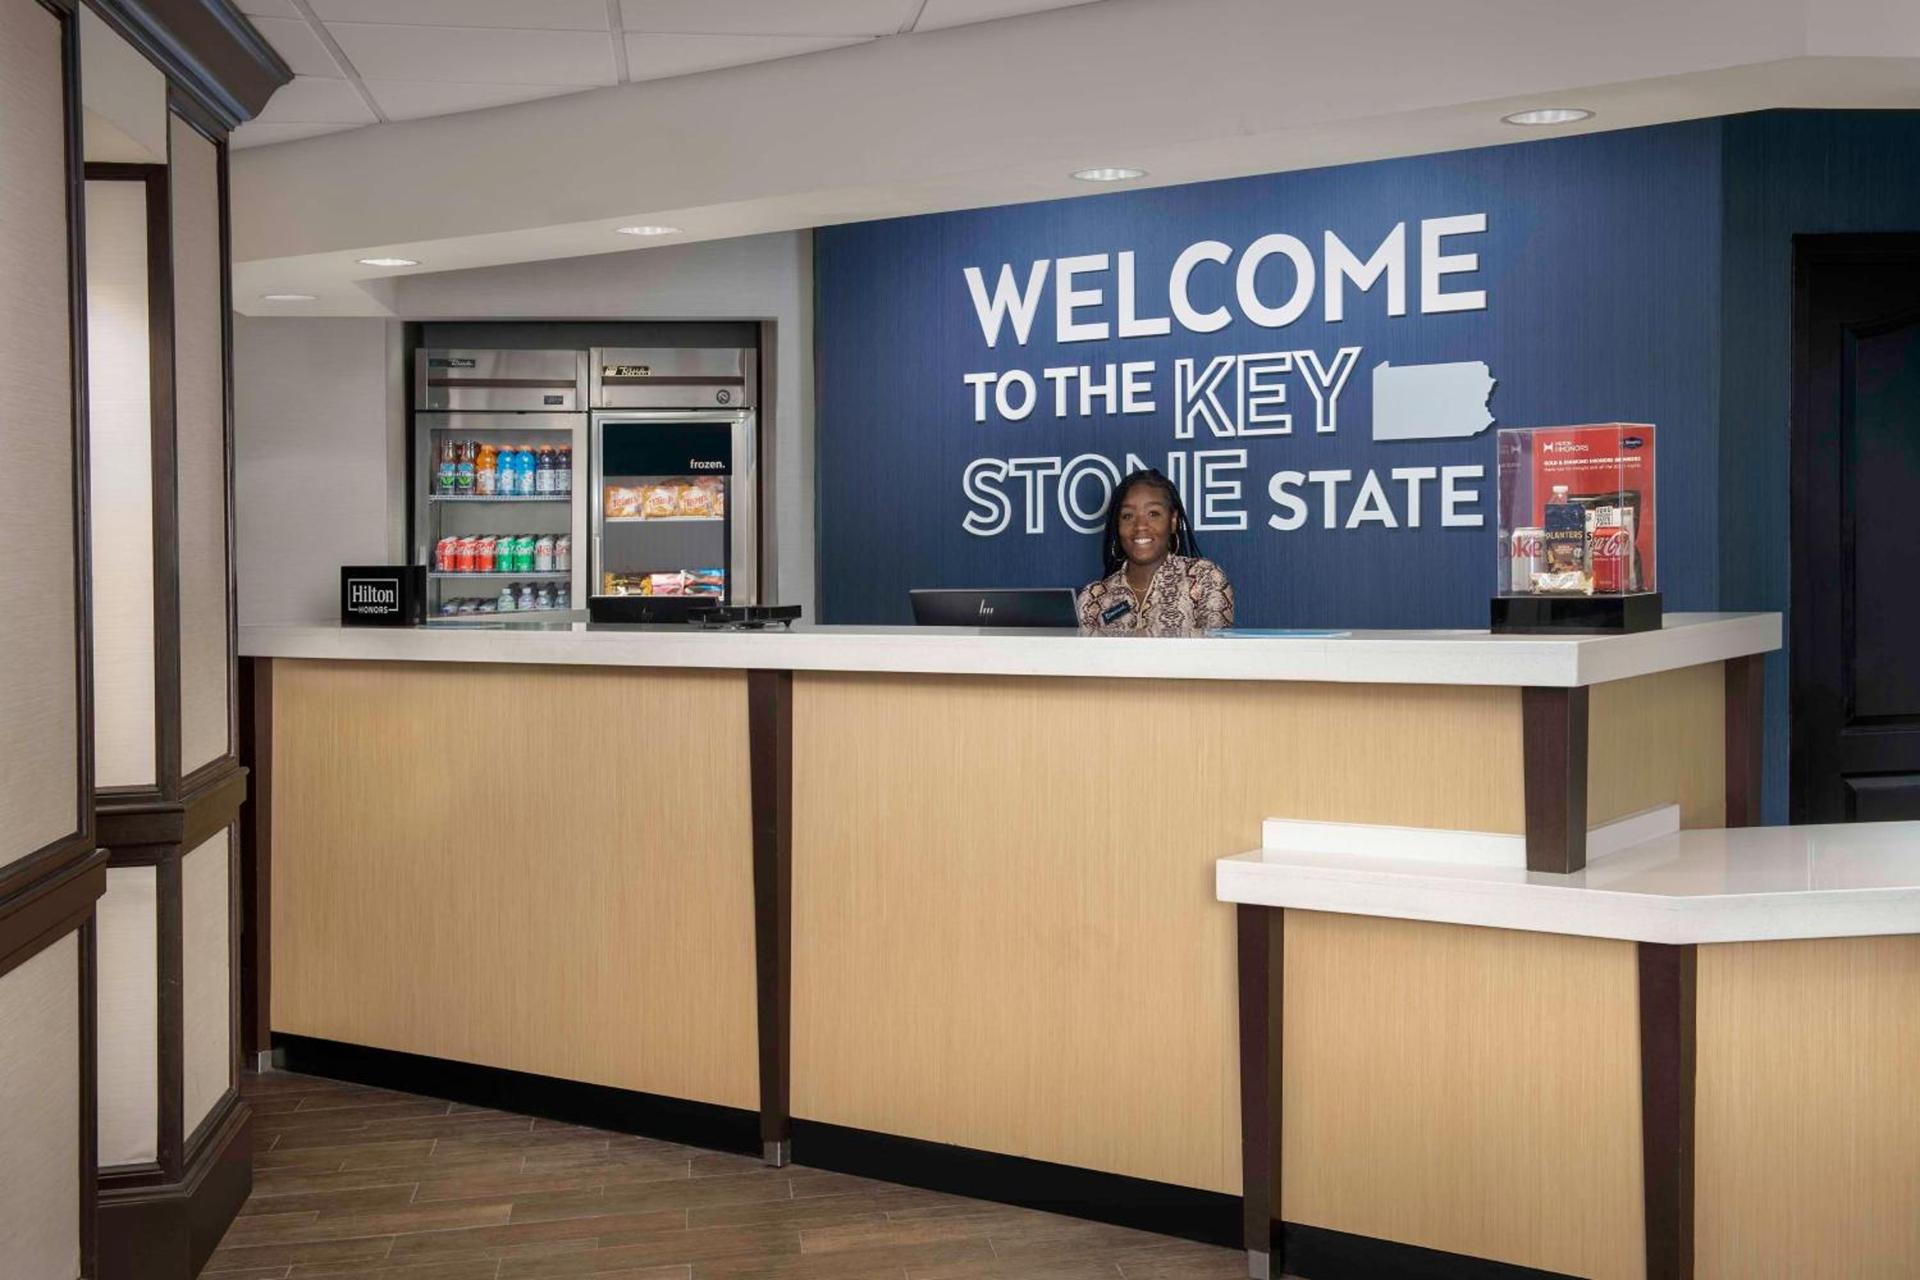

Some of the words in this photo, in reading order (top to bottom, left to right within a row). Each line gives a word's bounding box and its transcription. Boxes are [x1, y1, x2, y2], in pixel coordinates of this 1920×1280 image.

[963, 213, 1488, 348] WELCOME
[963, 369, 1037, 422] TO
[1044, 361, 1157, 418] THE
[1174, 346, 1363, 440] KEY
[690, 458, 726, 470] frozen.
[1267, 465, 1485, 532] STATE
[1545, 530, 1584, 540] PLANTERS
[352, 584, 395, 603] Hilton
[358, 605, 389, 614] HONORS
